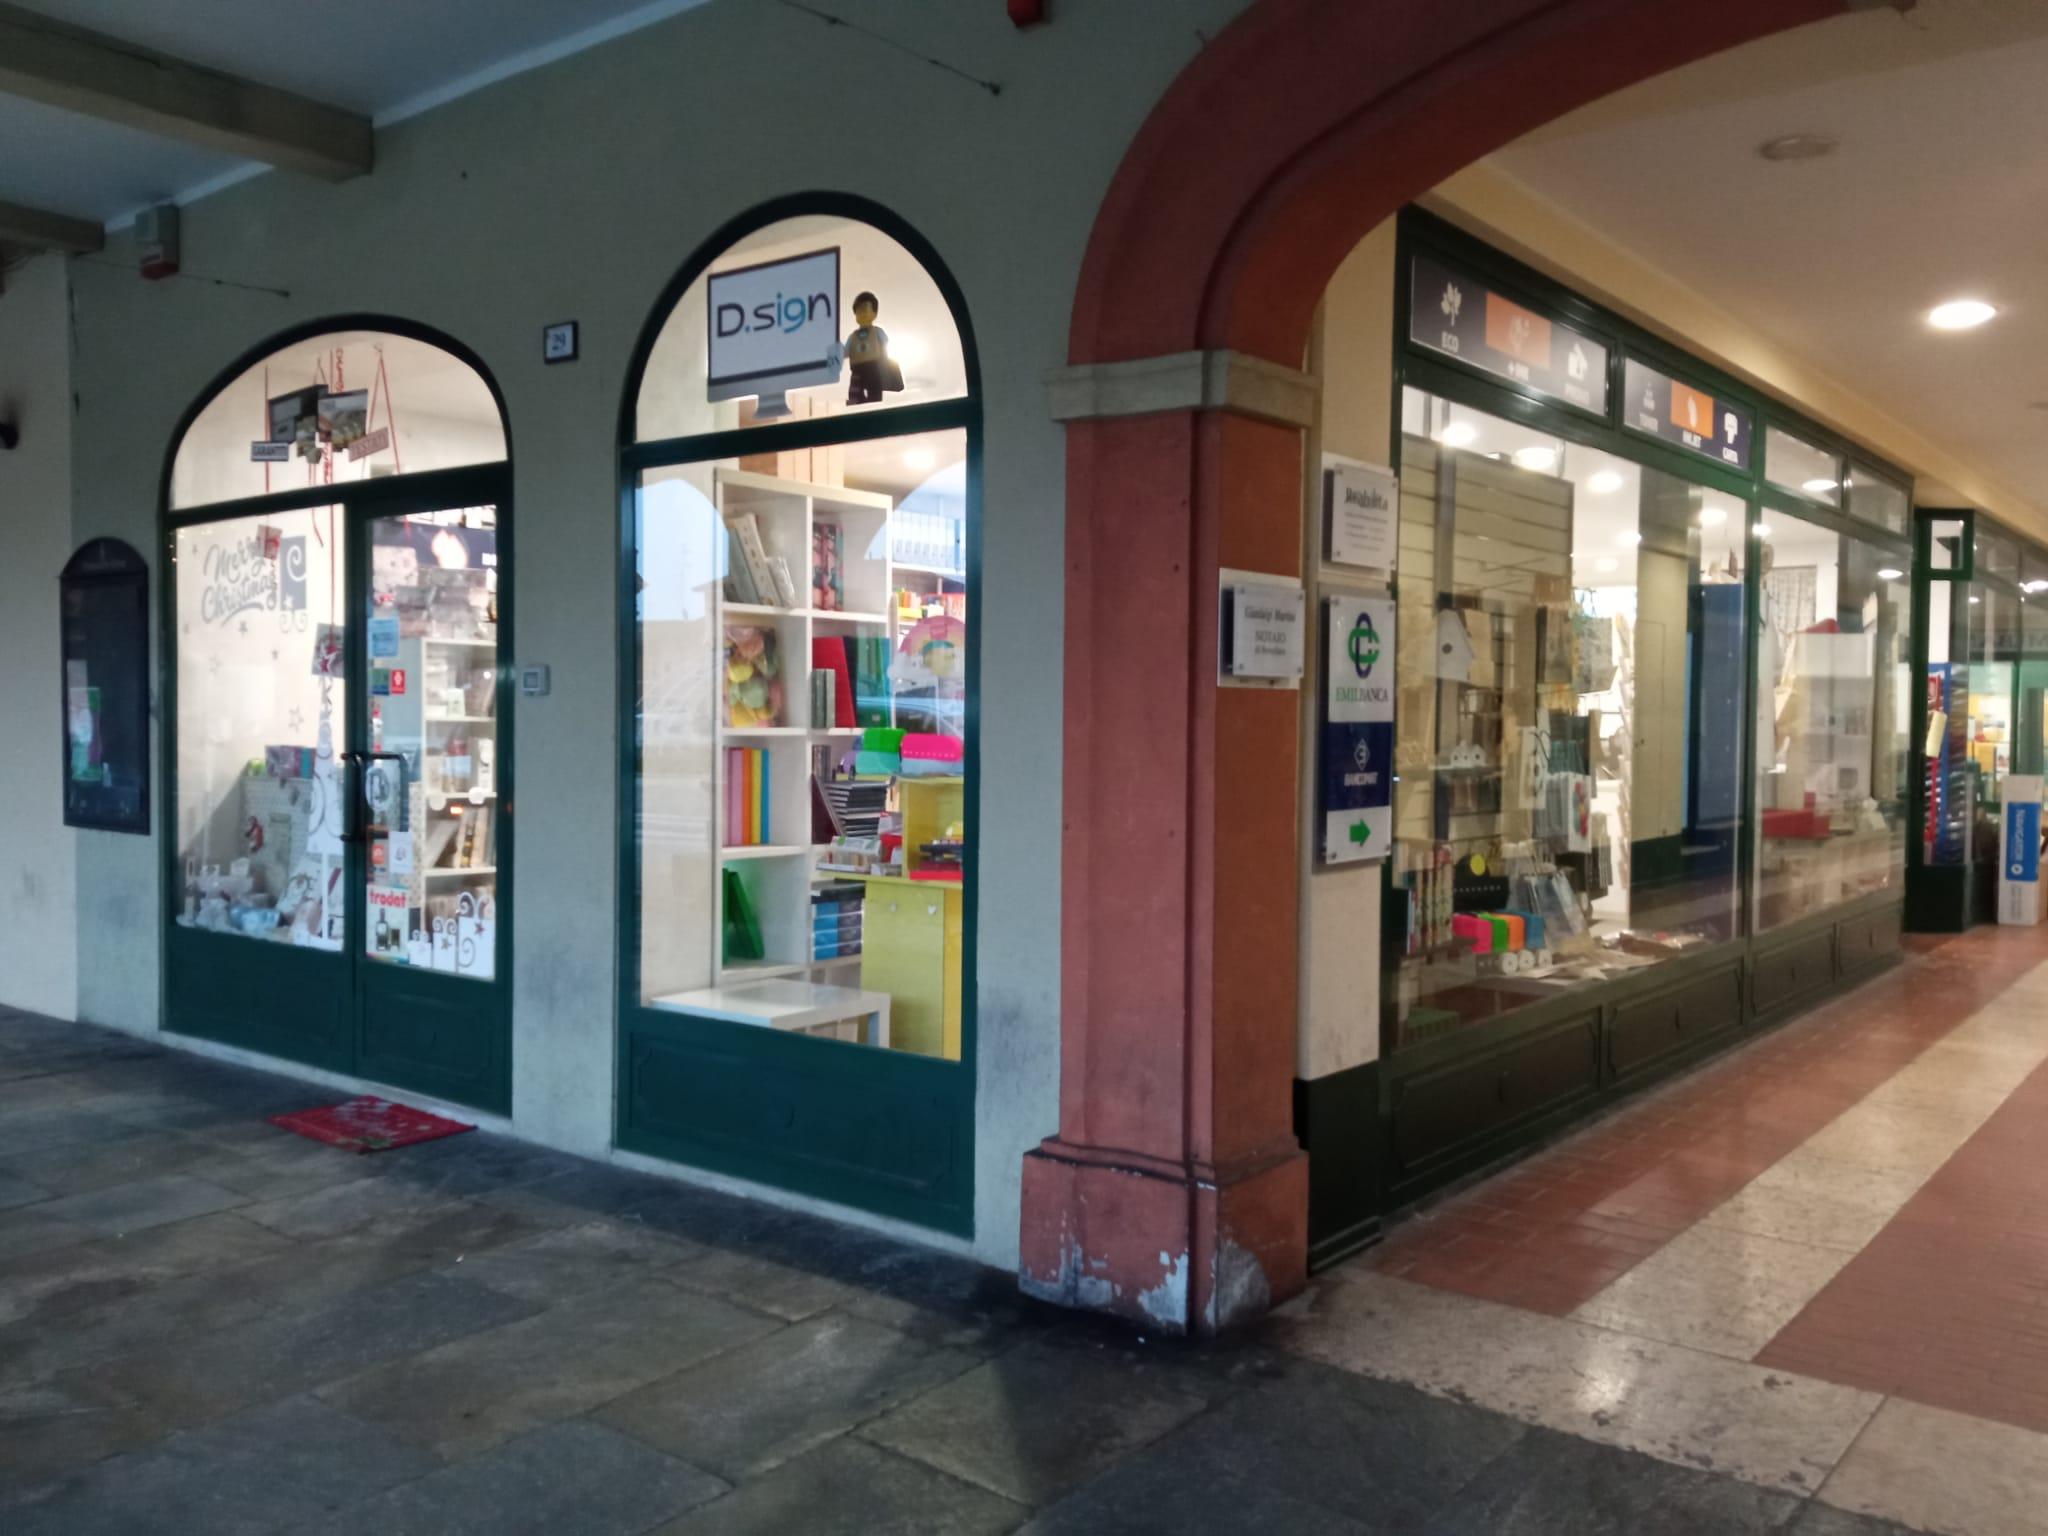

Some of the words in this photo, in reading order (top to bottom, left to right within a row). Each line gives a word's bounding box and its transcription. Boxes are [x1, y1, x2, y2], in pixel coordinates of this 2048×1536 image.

[717, 292, 832, 338] D.sign
[1441, 331, 1459, 353] ECO
[1336, 687, 1389, 702] EMILBANCA
[369, 888, 407, 908] trodat
